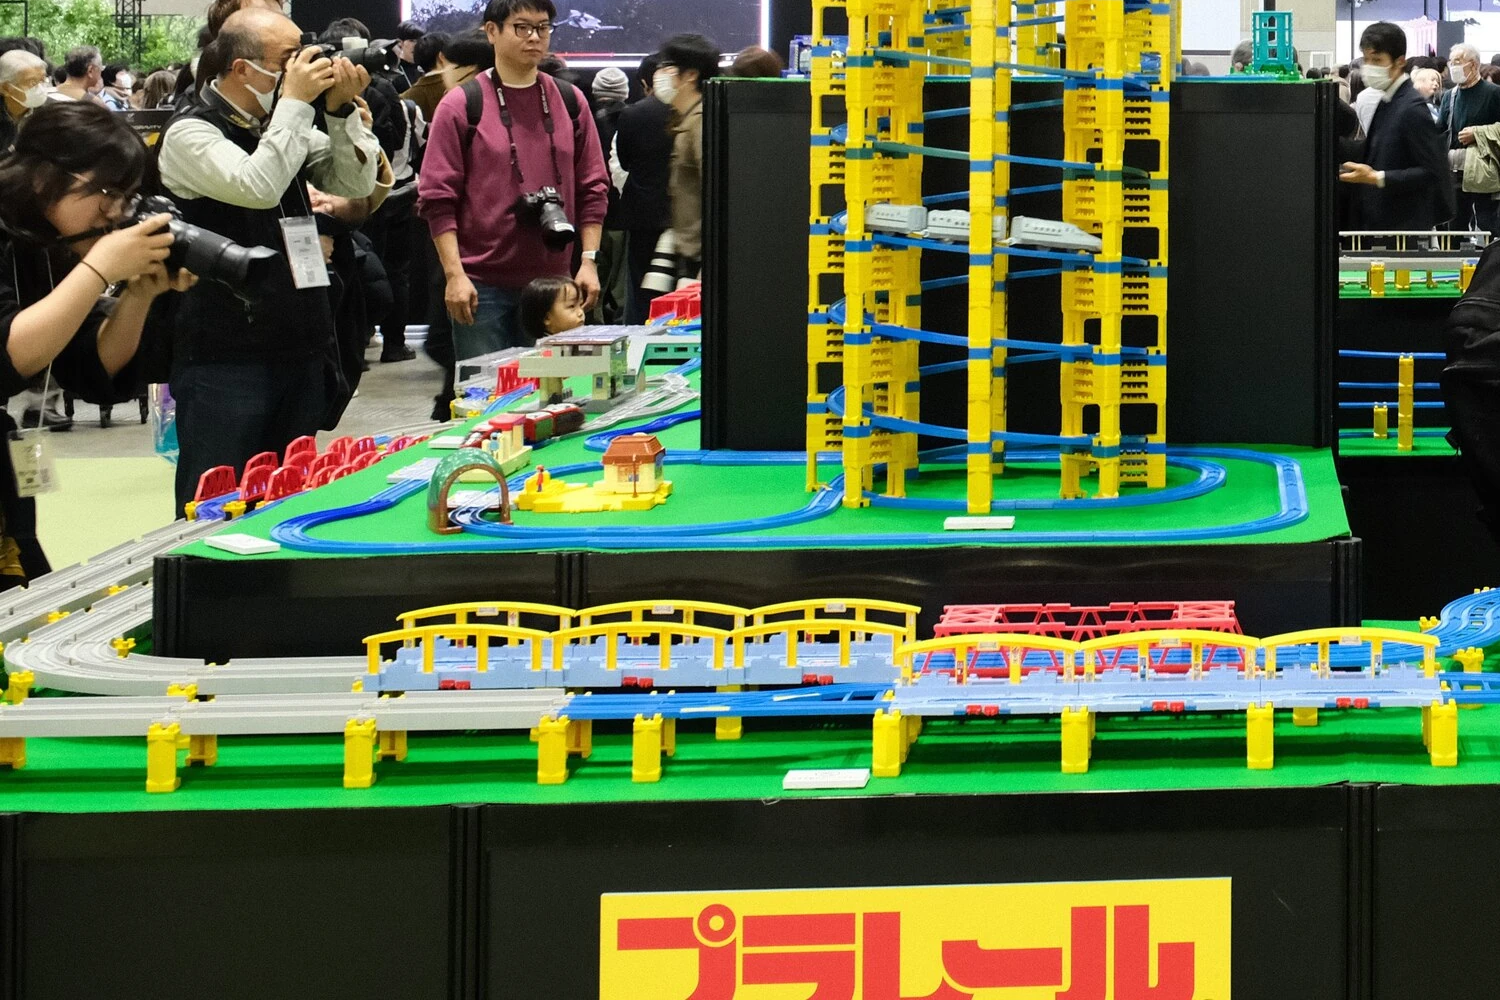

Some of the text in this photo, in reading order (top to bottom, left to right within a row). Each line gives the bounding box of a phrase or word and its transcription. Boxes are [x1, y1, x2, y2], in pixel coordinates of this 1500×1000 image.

[616, 903, 1196, 1000] プラレール
